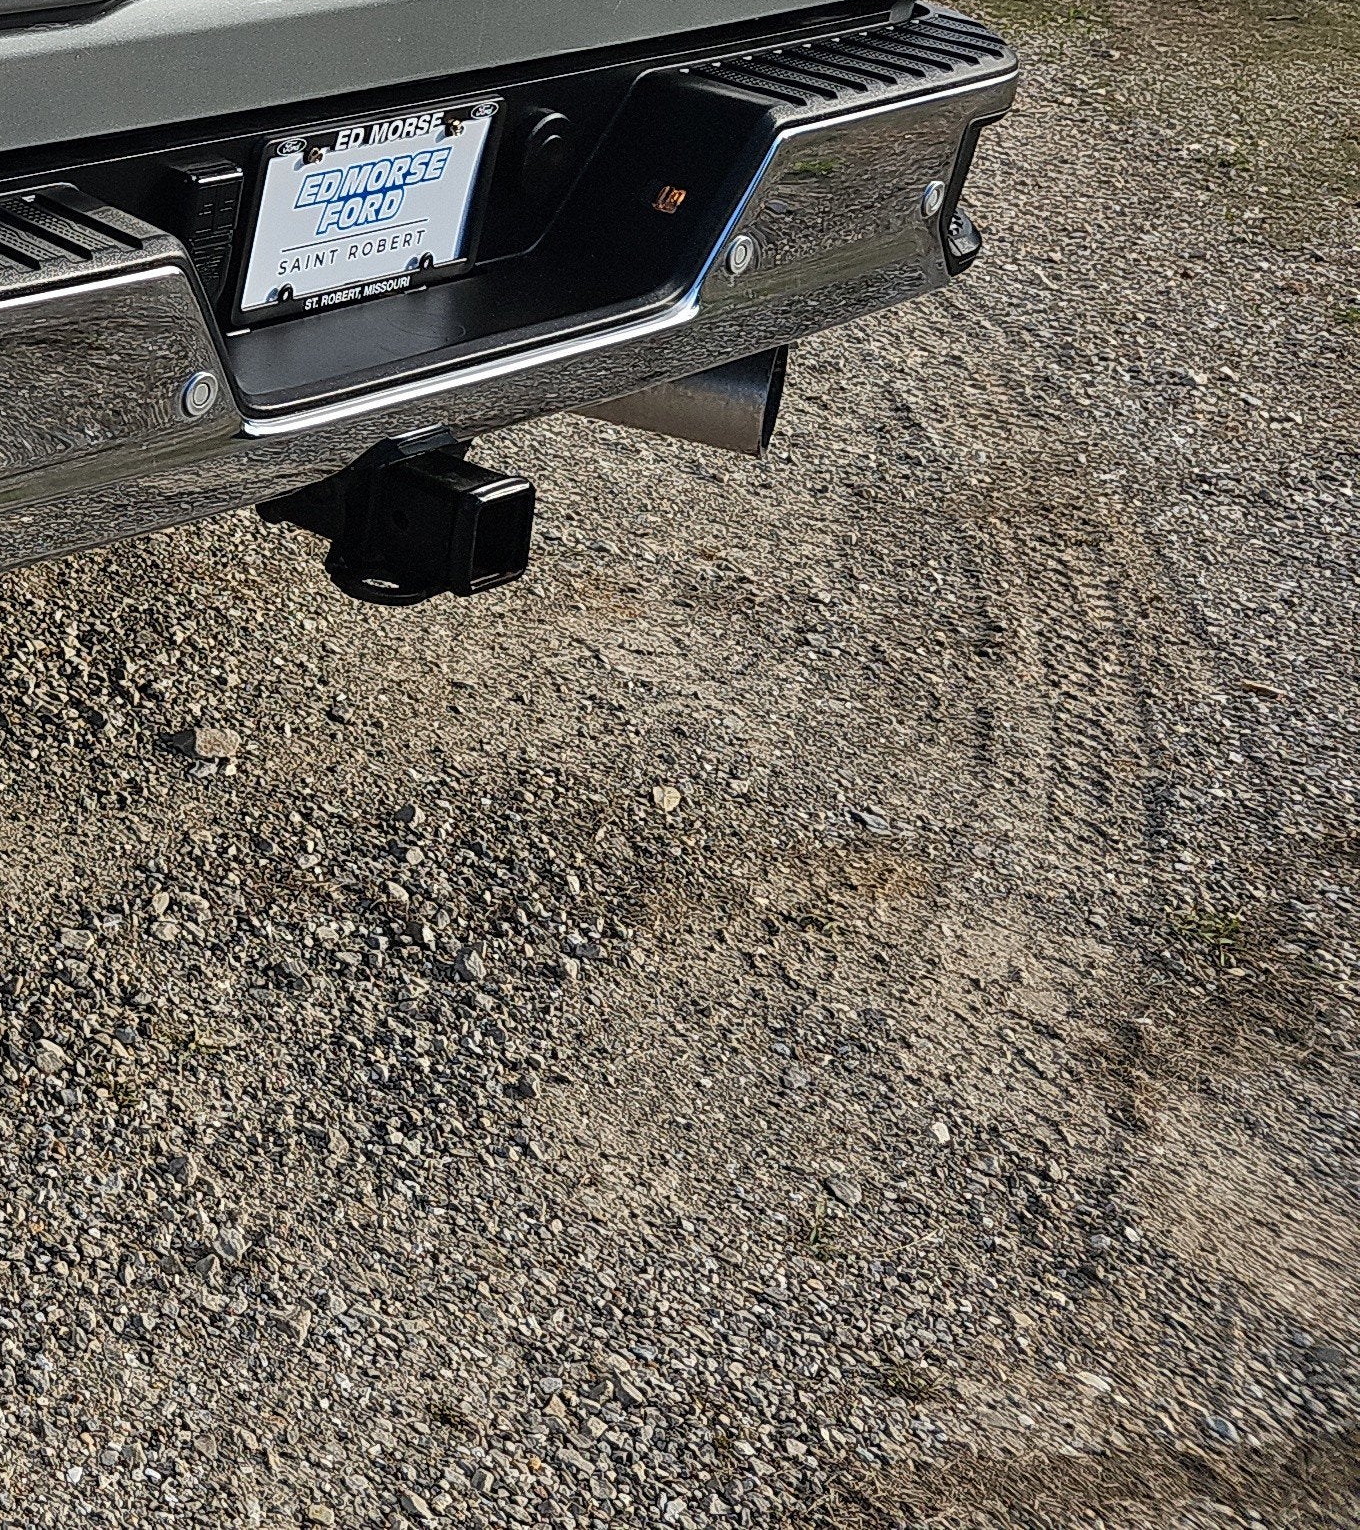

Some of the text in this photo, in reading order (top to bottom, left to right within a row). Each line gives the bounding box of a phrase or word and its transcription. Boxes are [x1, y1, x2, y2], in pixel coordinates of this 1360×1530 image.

[335, 112, 445, 151] ED MORSE
[294, 147, 453, 209] ED MORSE
[316, 187, 405, 235] FORD
[277, 230, 426, 276] SAINT ROBERT
[304, 276, 411, 311] ST. ROBERT, MISSOURI
